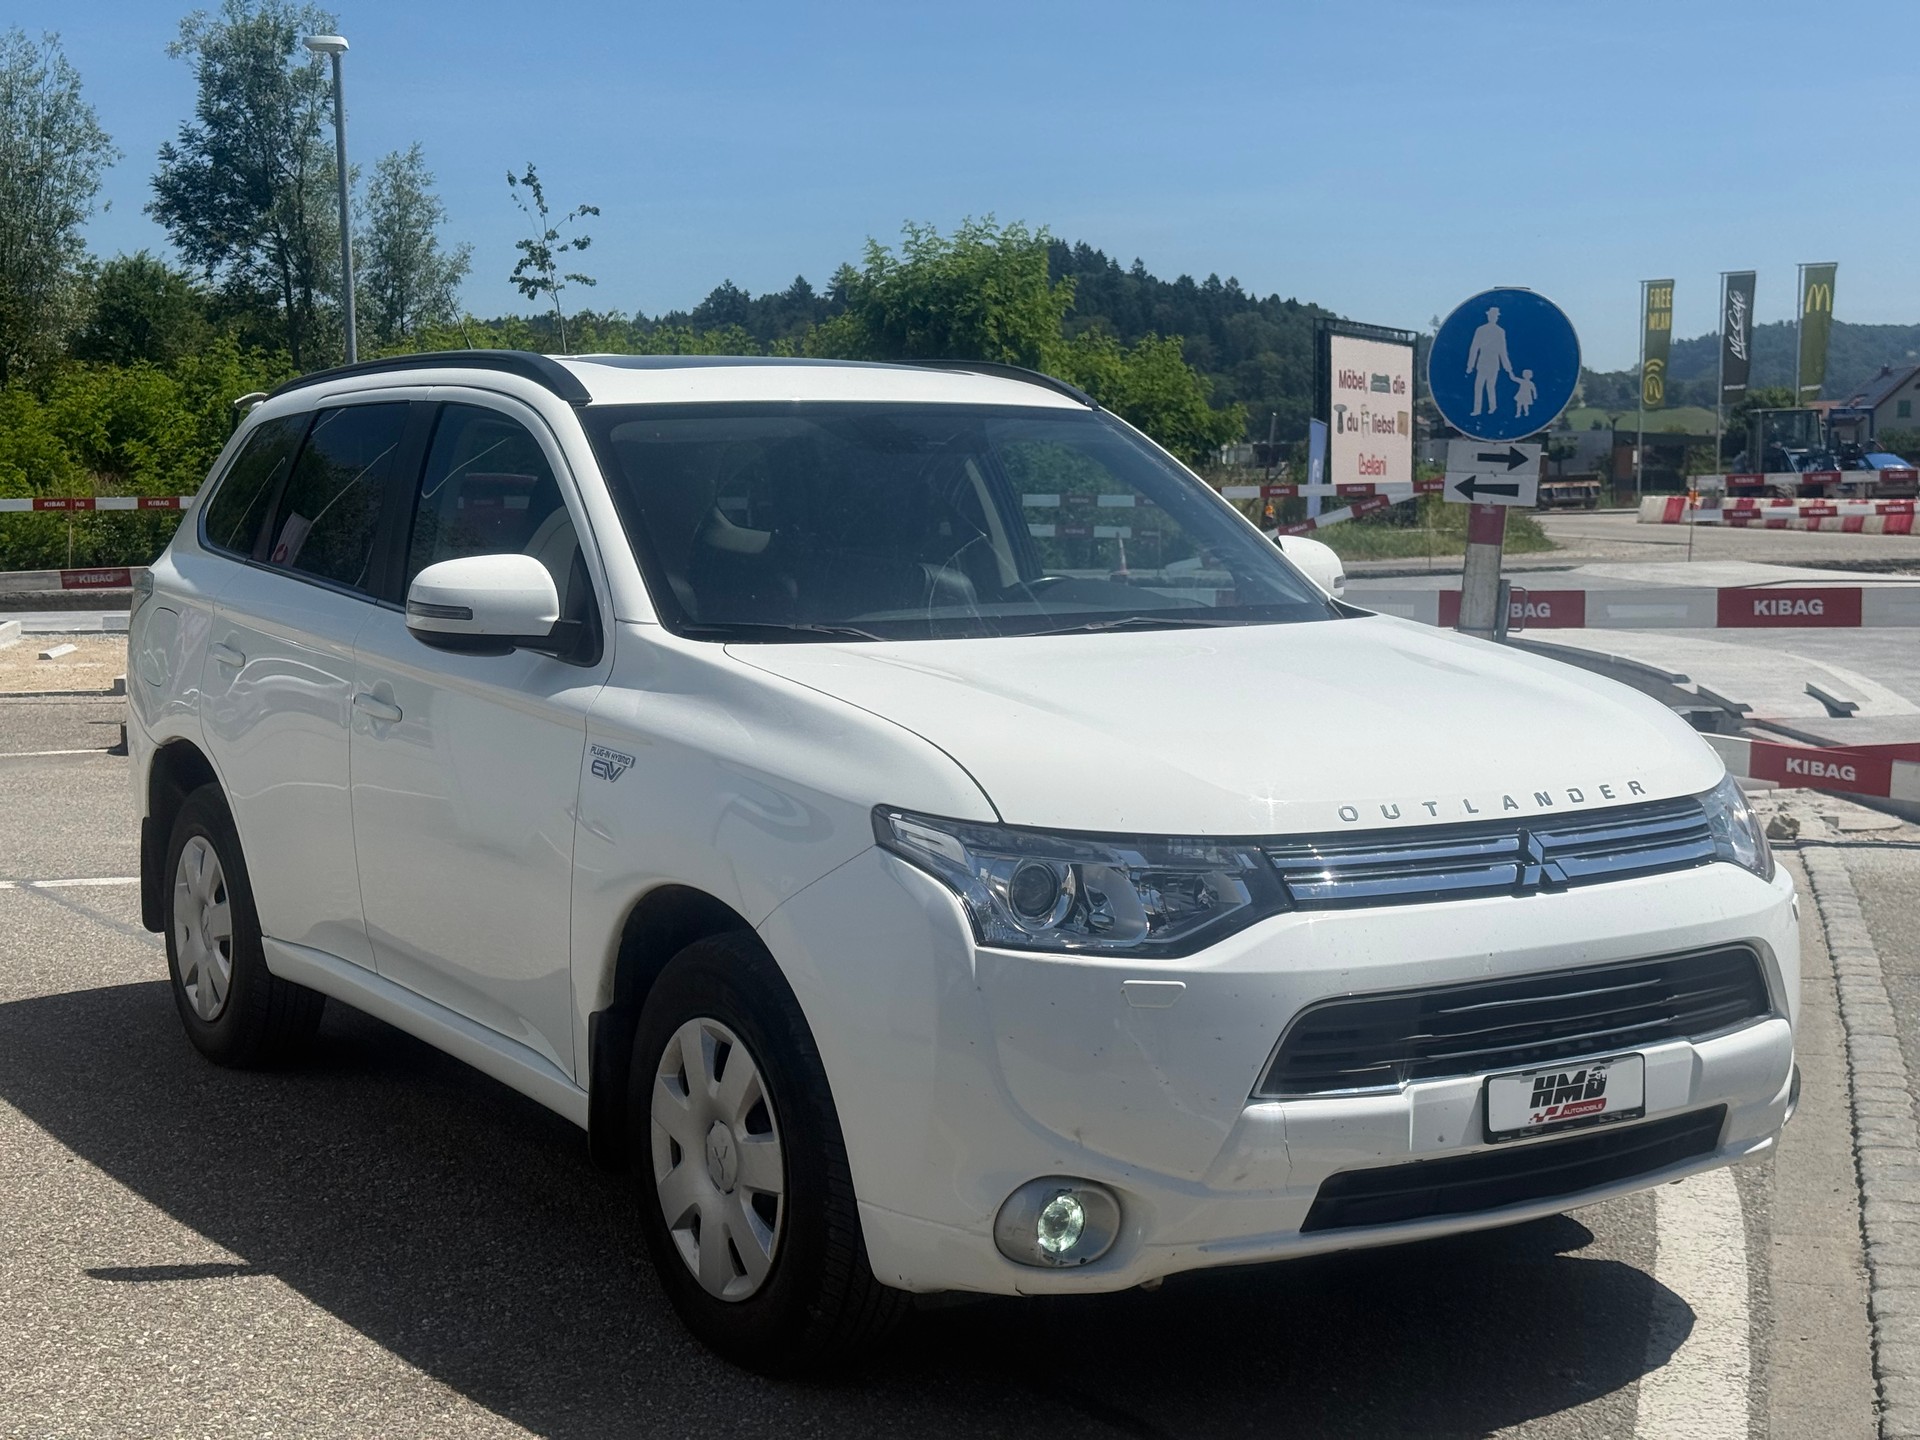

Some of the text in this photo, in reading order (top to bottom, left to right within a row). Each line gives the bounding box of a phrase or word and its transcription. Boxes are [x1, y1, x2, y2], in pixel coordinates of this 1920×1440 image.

[1650, 287, 1672, 308] FREE
[1338, 369, 1406, 395] Möbel, die
[1346, 412, 1395, 435] du liebst
[79, 574, 114, 584] KIBAG
[1511, 602, 1551, 618] BAG
[1753, 599, 1824, 617] KIBAG
[590, 745, 631, 765] PLUG-IN HYBRID
[1786, 757, 1856, 782] KIBAG
[1338, 780, 1646, 821] OUTLANDER
[1563, 1103, 1602, 1115] AUTOMOBILE
